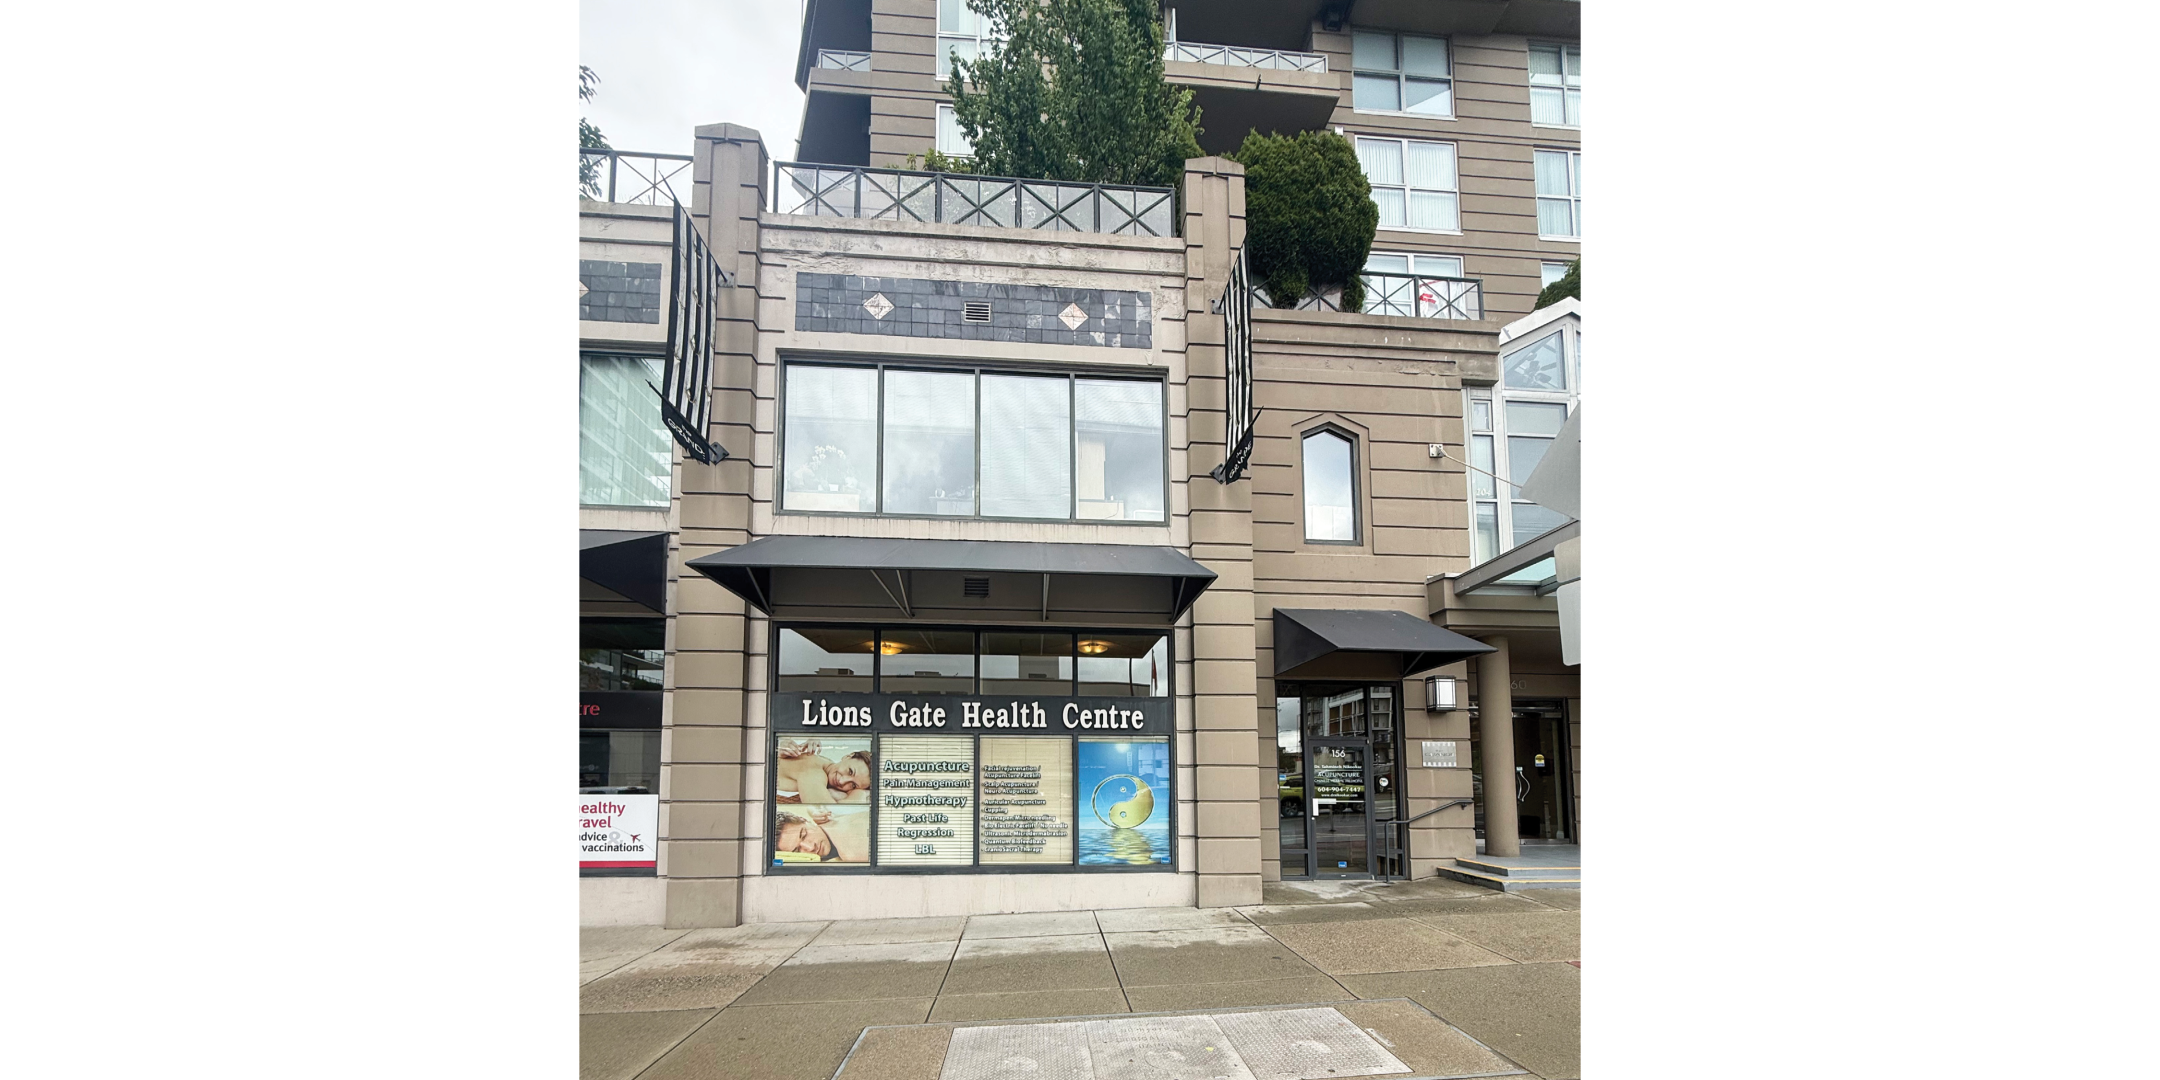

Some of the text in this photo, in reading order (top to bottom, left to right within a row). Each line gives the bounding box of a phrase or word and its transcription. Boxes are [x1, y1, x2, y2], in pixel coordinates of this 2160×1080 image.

[801, 699, 1145, 729] Lions Gate Health Centre
[1331, 749, 1346, 758] 156
[883, 760, 970, 775] Acupuncture
[1001, 765, 1037, 773] rejuvenation
[883, 778, 970, 790] Pain Management
[884, 794, 968, 809] Hypnotherapy
[903, 813, 949, 823] Past Life
[897, 827, 955, 840] Regression
[581, 842, 645, 852] vaccinations
[914, 844, 937, 855] LBL
[1020, 846, 1043, 854] Therapy
